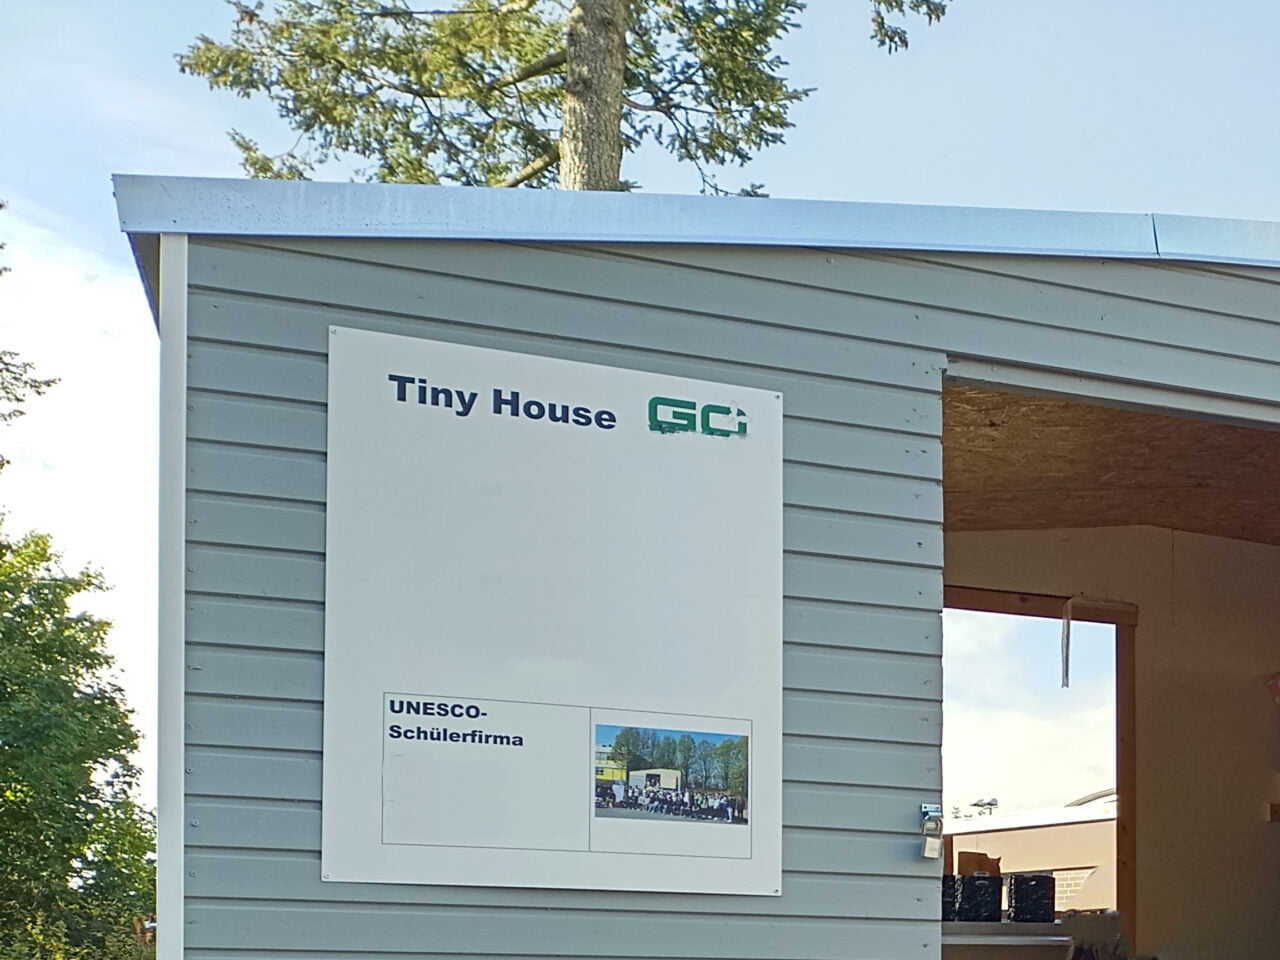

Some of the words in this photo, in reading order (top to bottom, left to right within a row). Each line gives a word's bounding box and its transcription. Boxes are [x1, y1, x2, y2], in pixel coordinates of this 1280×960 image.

[387, 374, 478, 416] Tiny
[492, 388, 617, 430] House
[389, 699, 488, 719] UNESCO-
[388, 724, 524, 747] Schülerfirma
